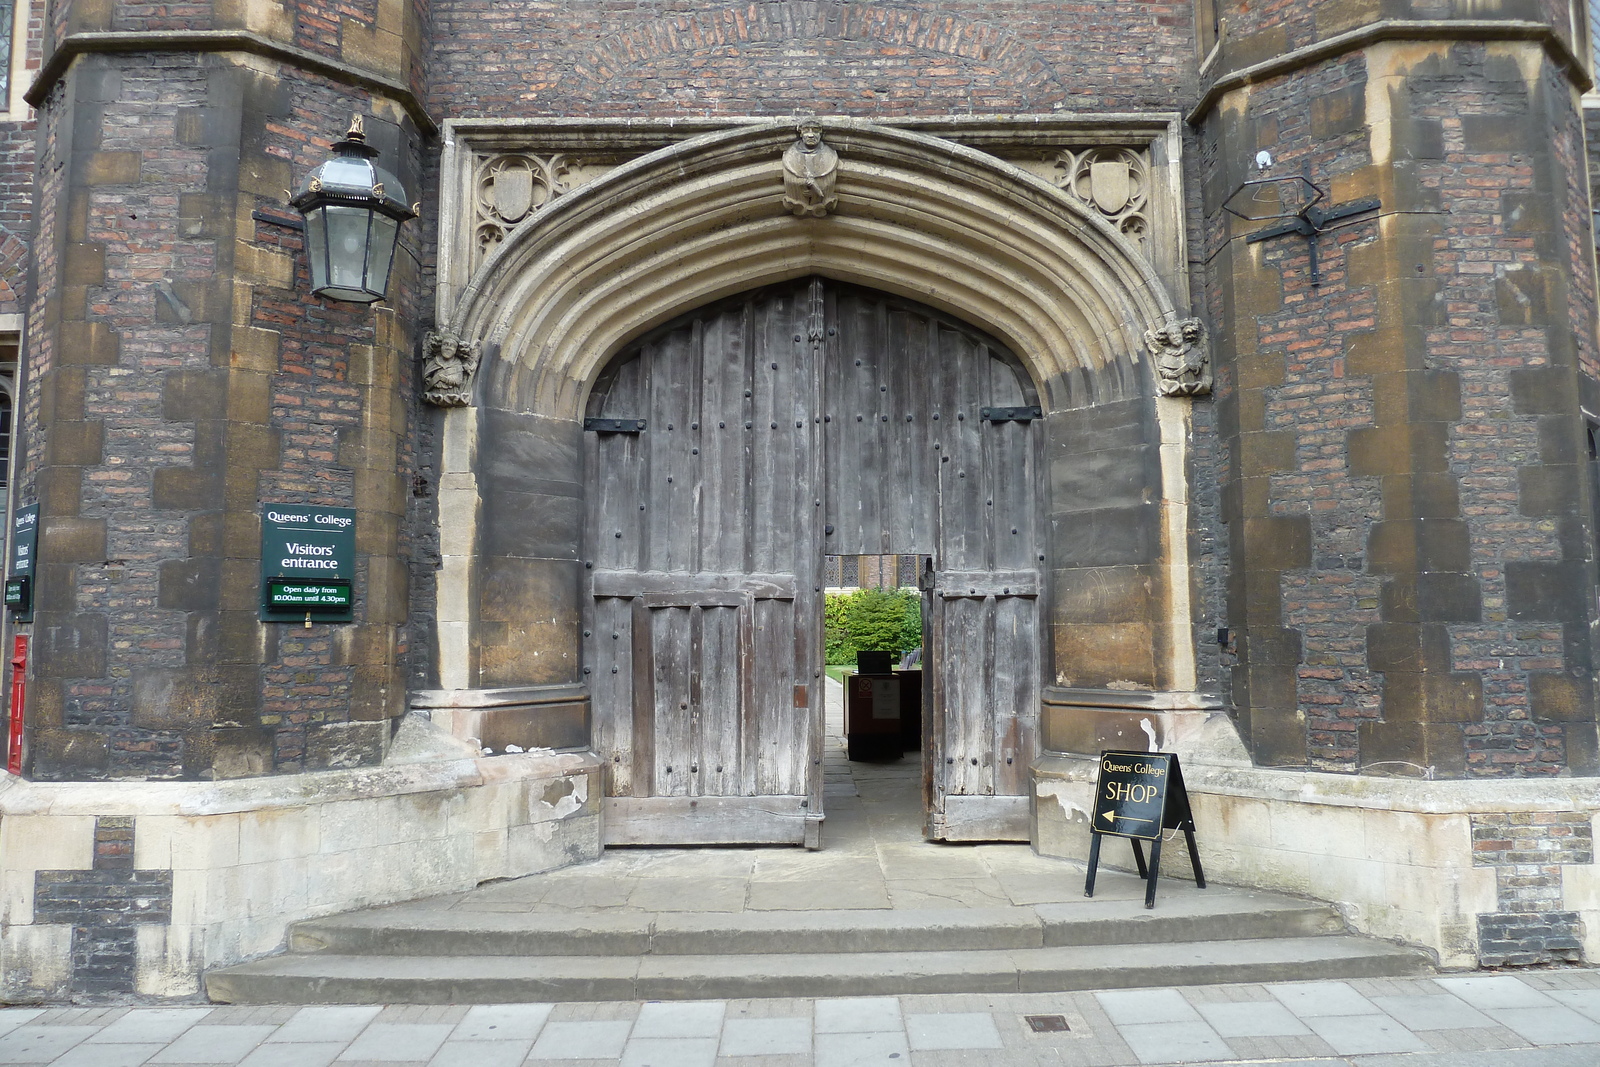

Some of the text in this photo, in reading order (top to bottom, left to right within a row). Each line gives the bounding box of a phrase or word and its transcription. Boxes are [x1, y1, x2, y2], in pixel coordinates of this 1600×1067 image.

[268, 511, 352, 527] Queens' College
[286, 542, 335, 555] Visitors'
[281, 557, 338, 569] entrance
[283, 586, 301, 594] Open
[303, 586, 320, 594] daily
[321, 595, 345, 603] 4.30pm
[1102, 760, 1165, 778] Queens' College
[1105, 781, 1157, 804] SHOP
